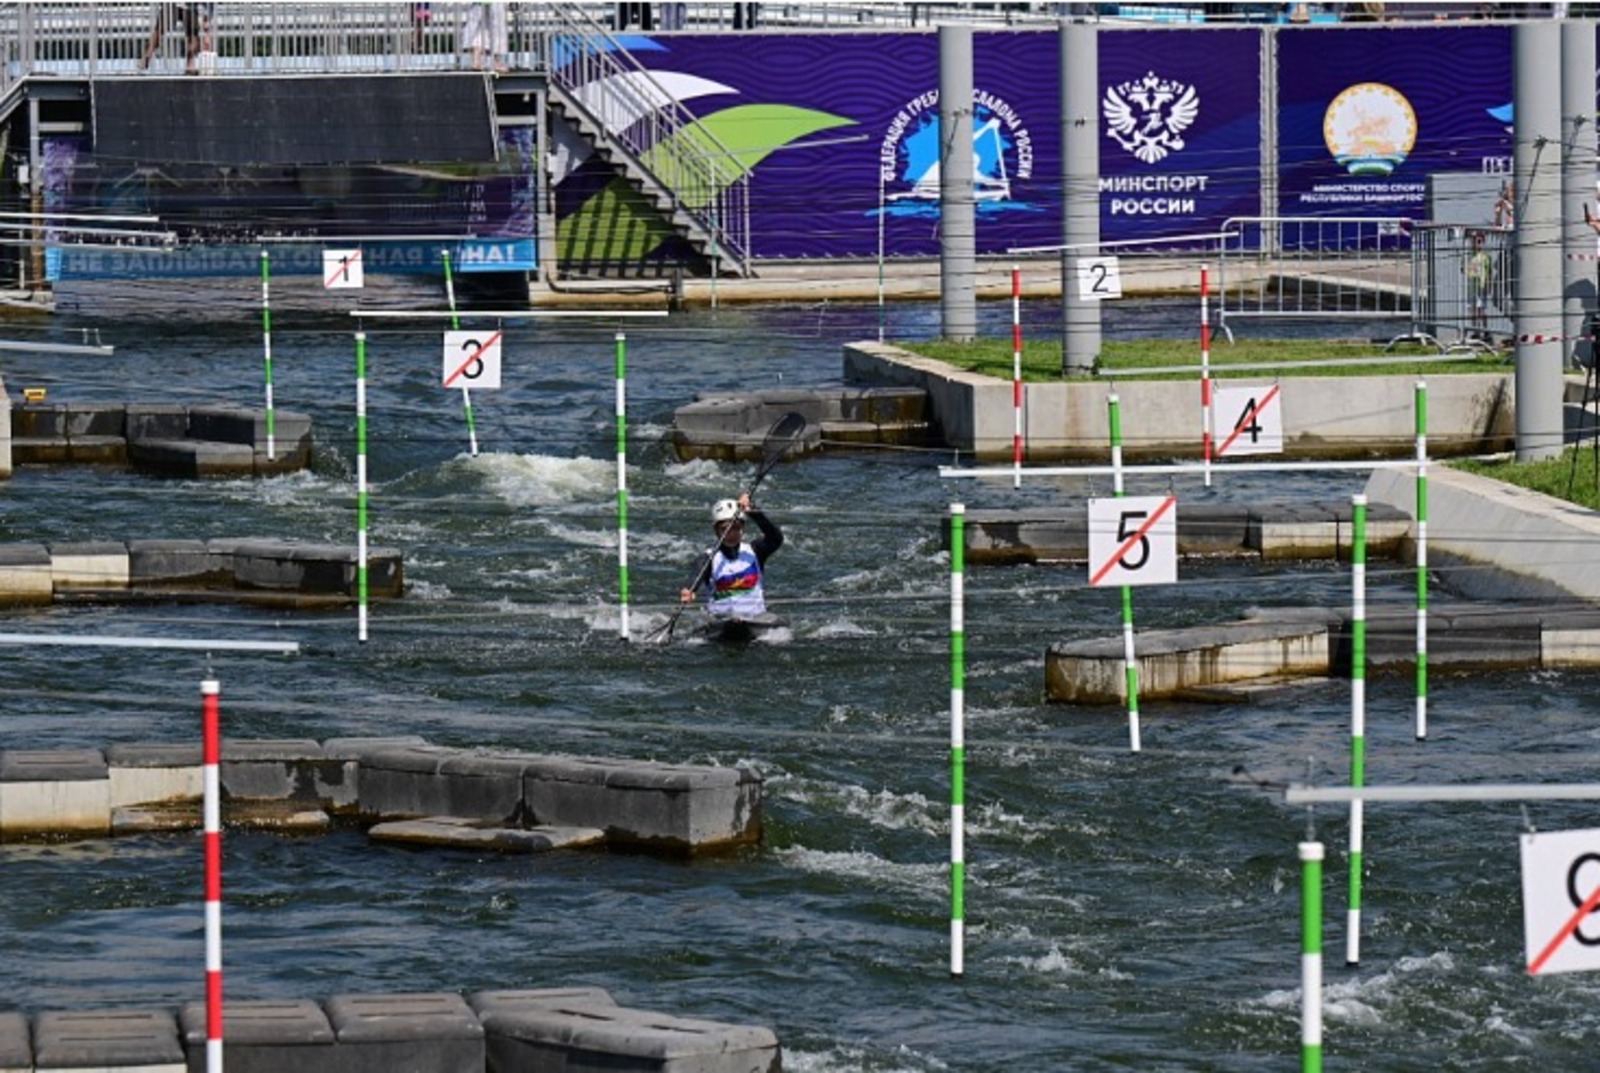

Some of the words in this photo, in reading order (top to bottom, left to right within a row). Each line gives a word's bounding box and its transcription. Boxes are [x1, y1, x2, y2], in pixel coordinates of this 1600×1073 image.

[880, 110, 911, 181] ФЕДЕРАЦИЯ
[1014, 129, 1034, 179] РОССИИ
[1098, 175, 1209, 192] МИНСПОРТ
[1111, 198, 1195, 214] РОССИИ
[69, 252, 103, 272] НЕ
[339, 255, 349, 281] 1
[1090, 264, 1109, 292] 2
[462, 339, 484, 379] 3
[1234, 398, 1263, 443] 4
[1117, 511, 1150, 570] 5
